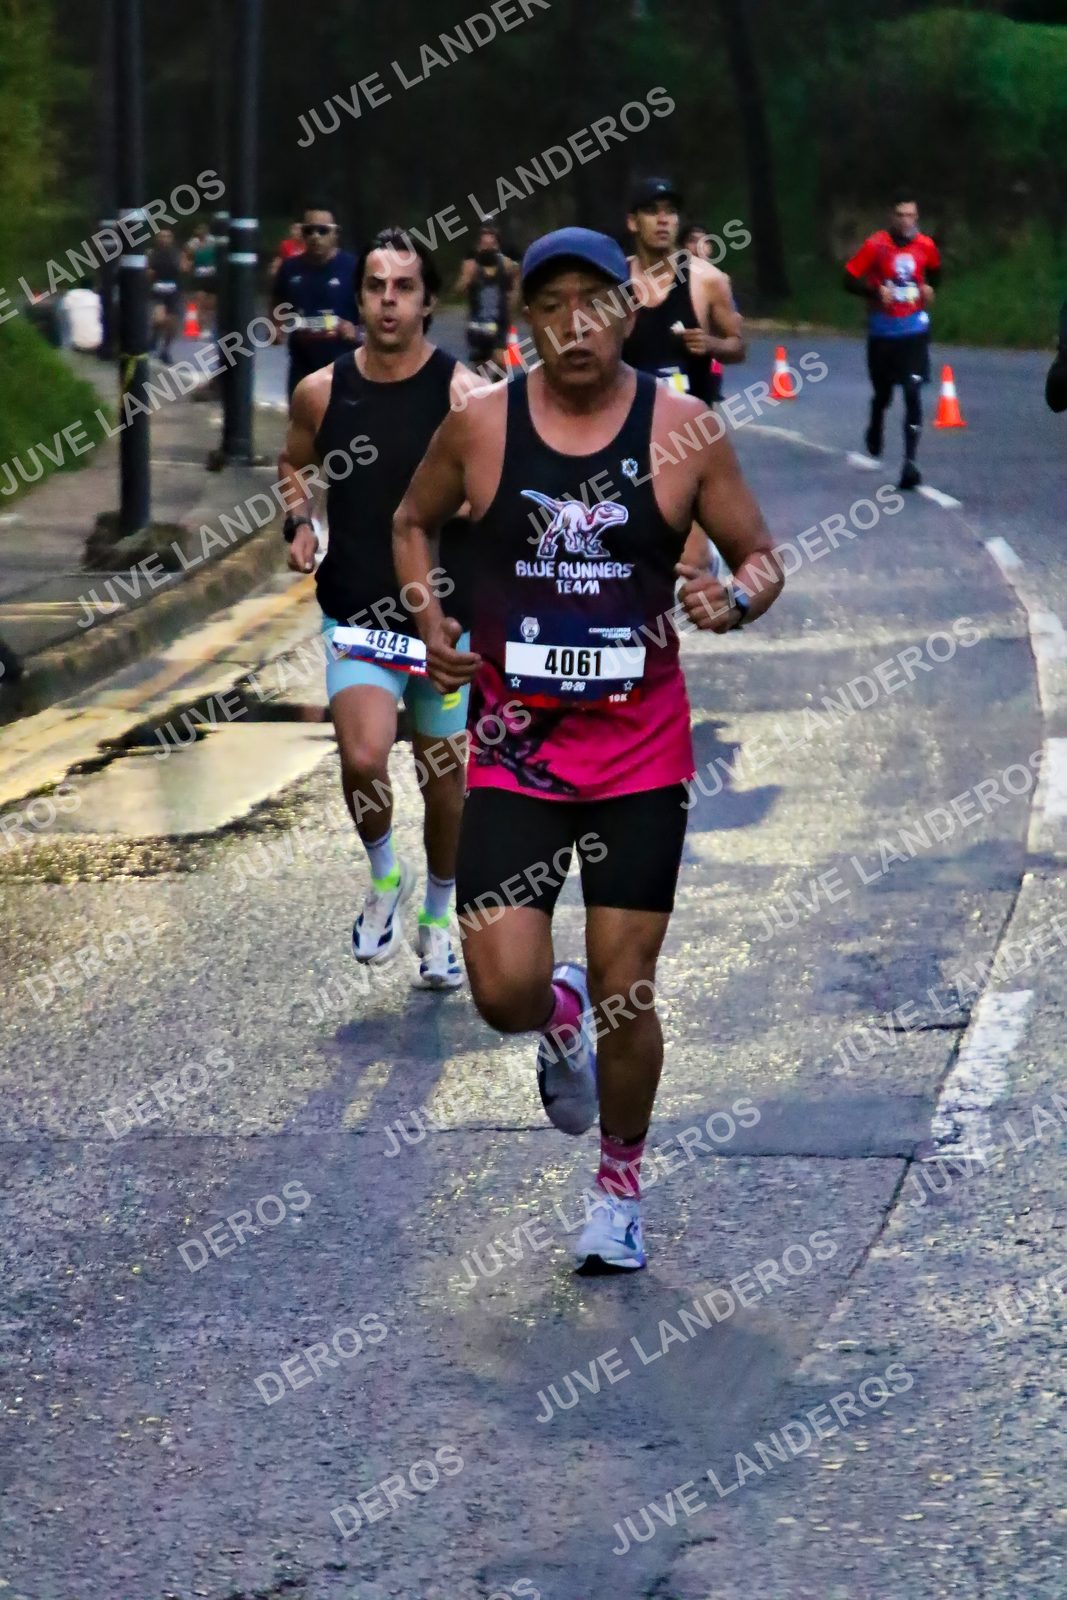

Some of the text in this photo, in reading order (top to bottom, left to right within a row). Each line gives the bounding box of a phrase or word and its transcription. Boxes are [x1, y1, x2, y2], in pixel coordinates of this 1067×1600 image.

[515, 560, 634, 579] BLUE RUNNERS
[556, 580, 600, 594] TEAM
[366, 630, 410, 654] 4643
[544, 648, 602, 677] 4061
